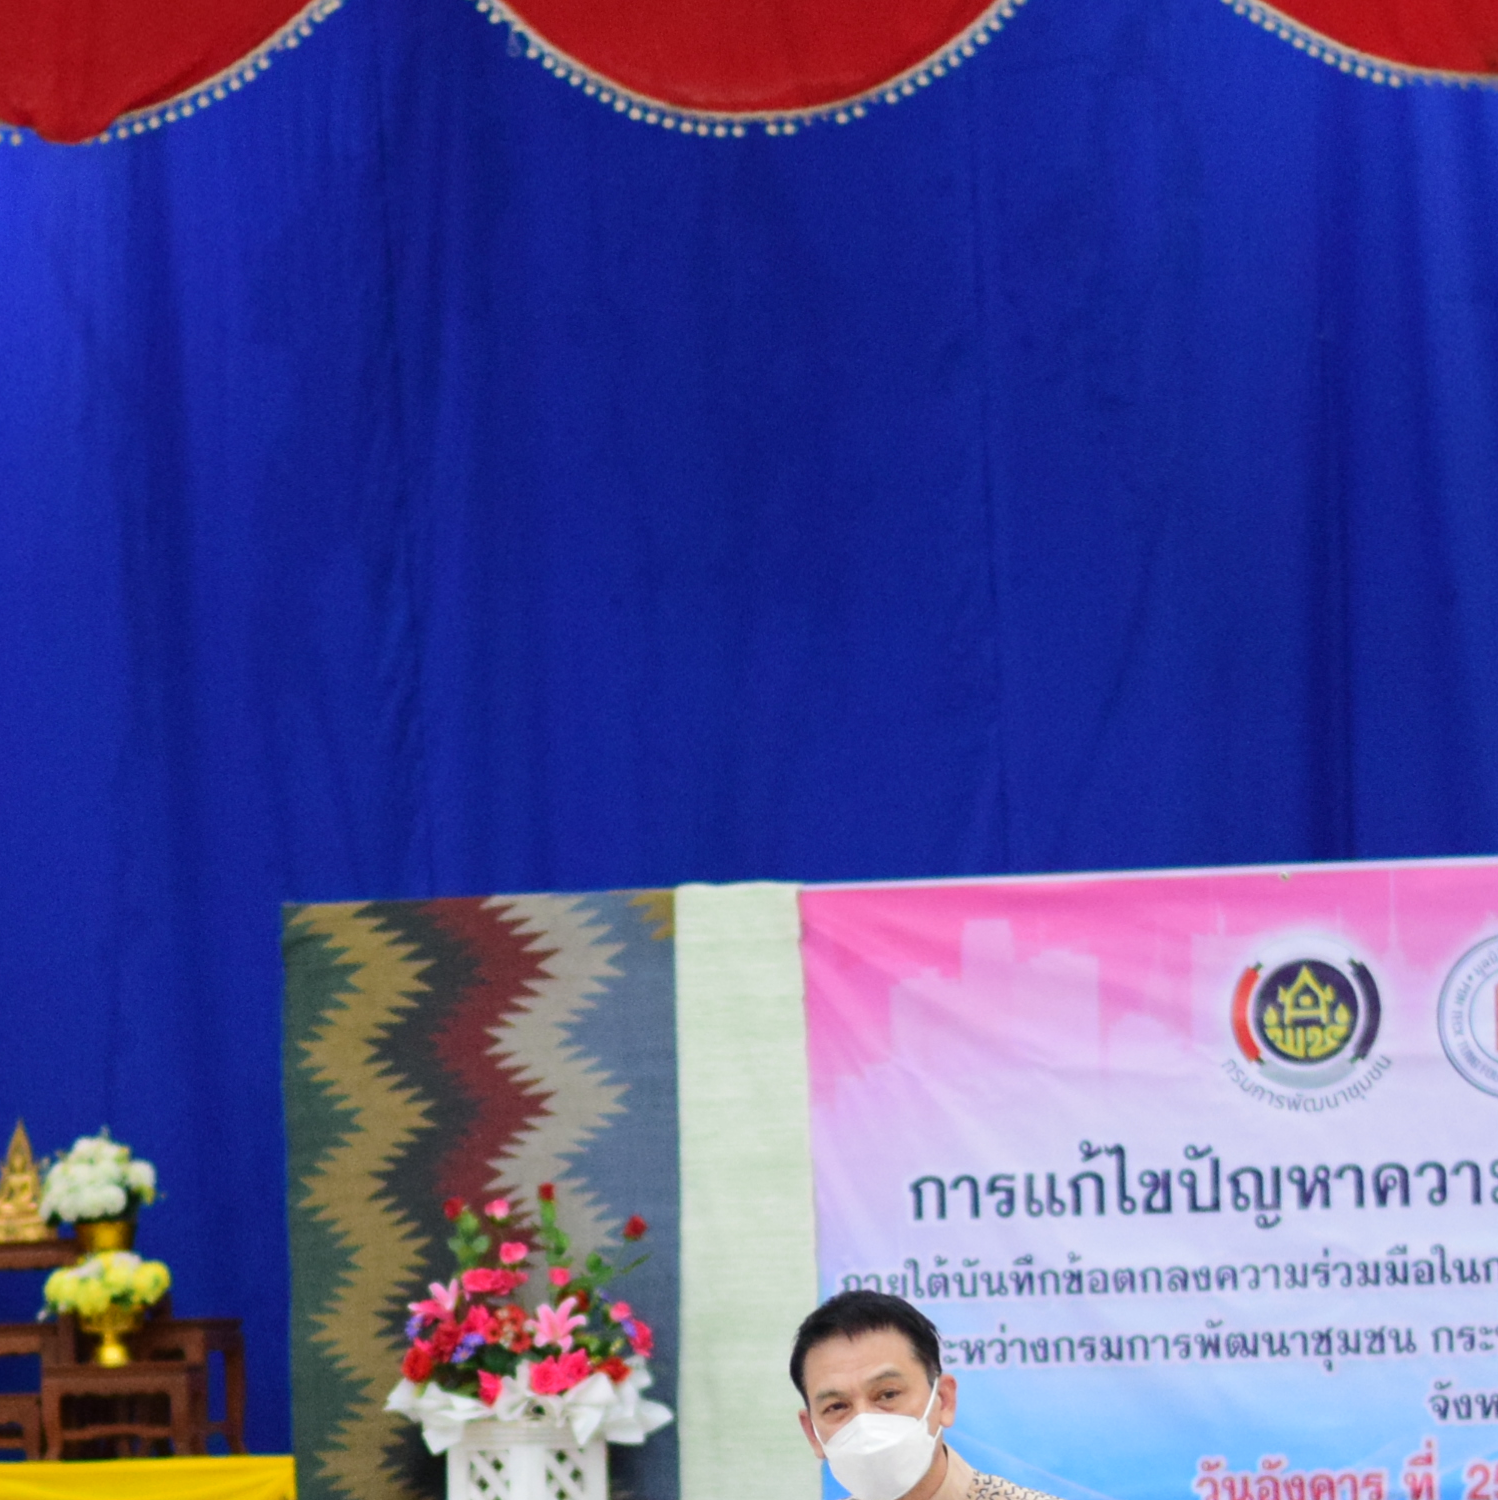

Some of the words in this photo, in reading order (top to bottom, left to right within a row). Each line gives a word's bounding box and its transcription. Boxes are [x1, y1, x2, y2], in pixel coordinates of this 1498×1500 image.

[942, 1318, 1417, 1372] ะหว่างกรมการพัฒนาชุมชน
